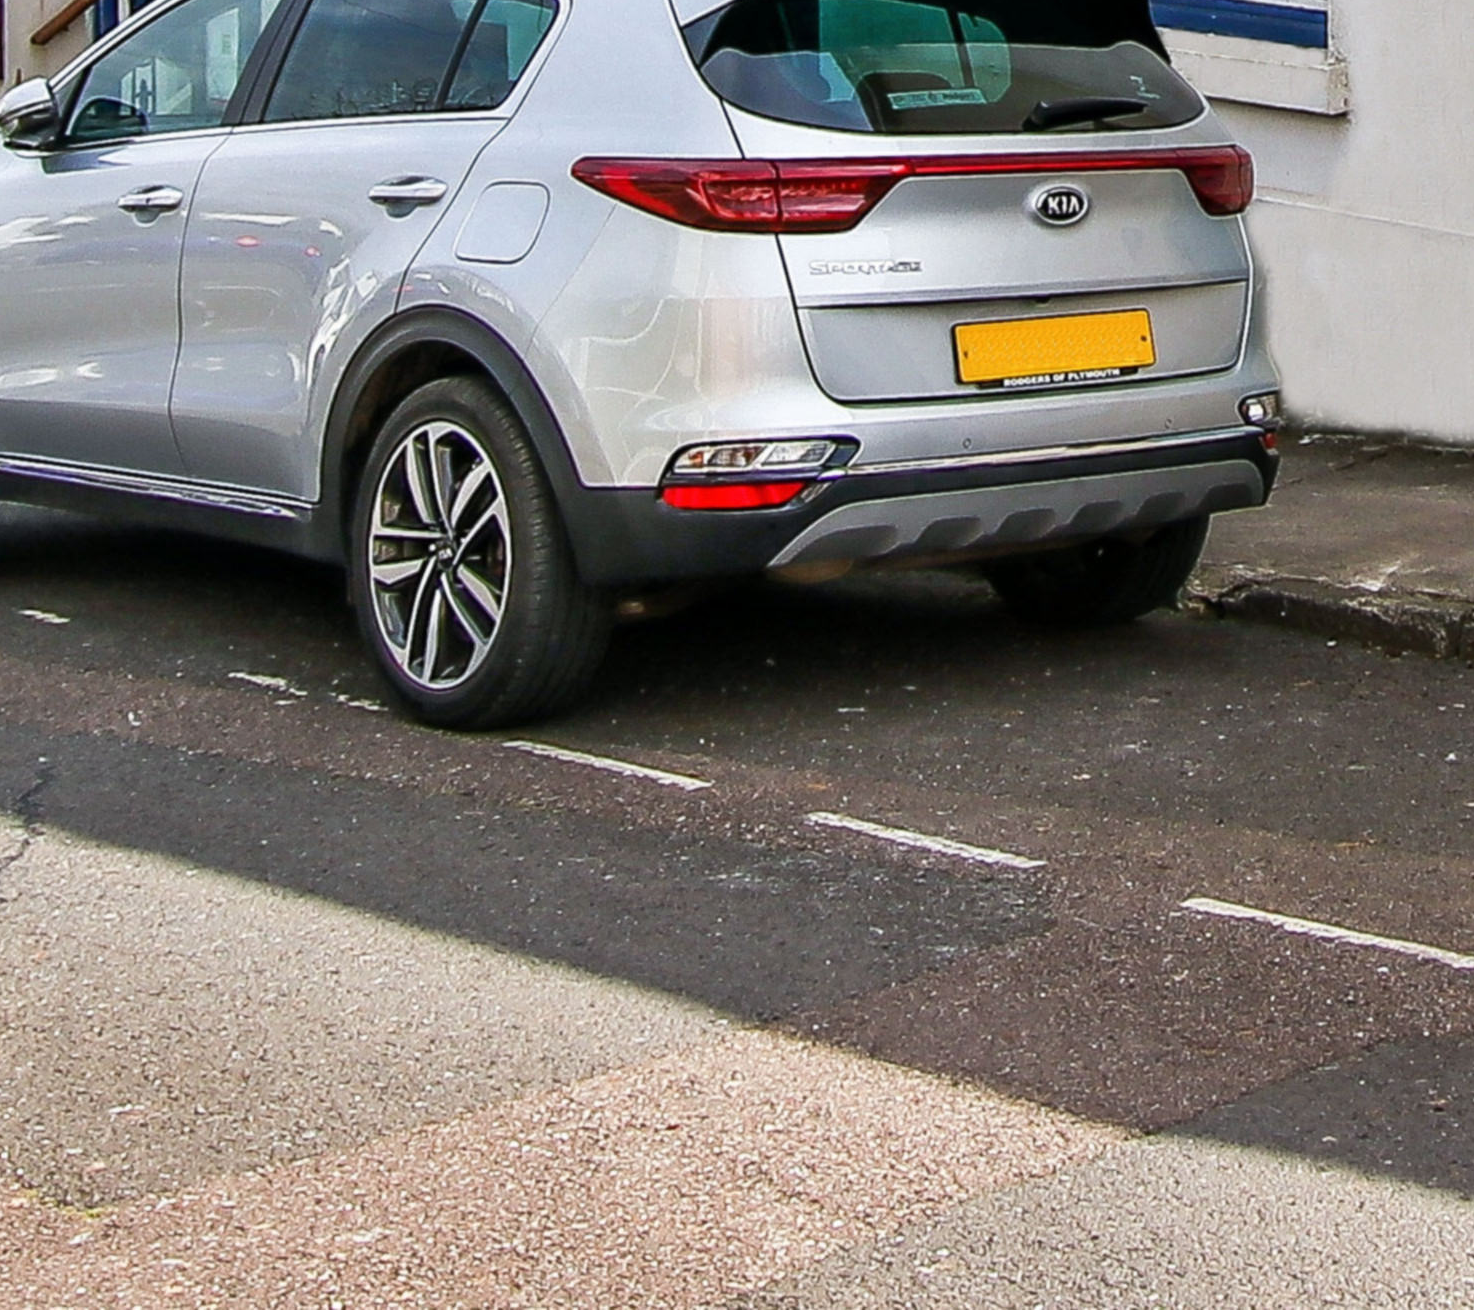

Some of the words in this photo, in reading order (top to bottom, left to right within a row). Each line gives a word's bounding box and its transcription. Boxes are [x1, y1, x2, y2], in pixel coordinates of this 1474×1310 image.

[1047, 195, 1080, 215] KIA
[1052, 372, 1067, 382] OF
[1067, 368, 1121, 381] PLYMOUTH
